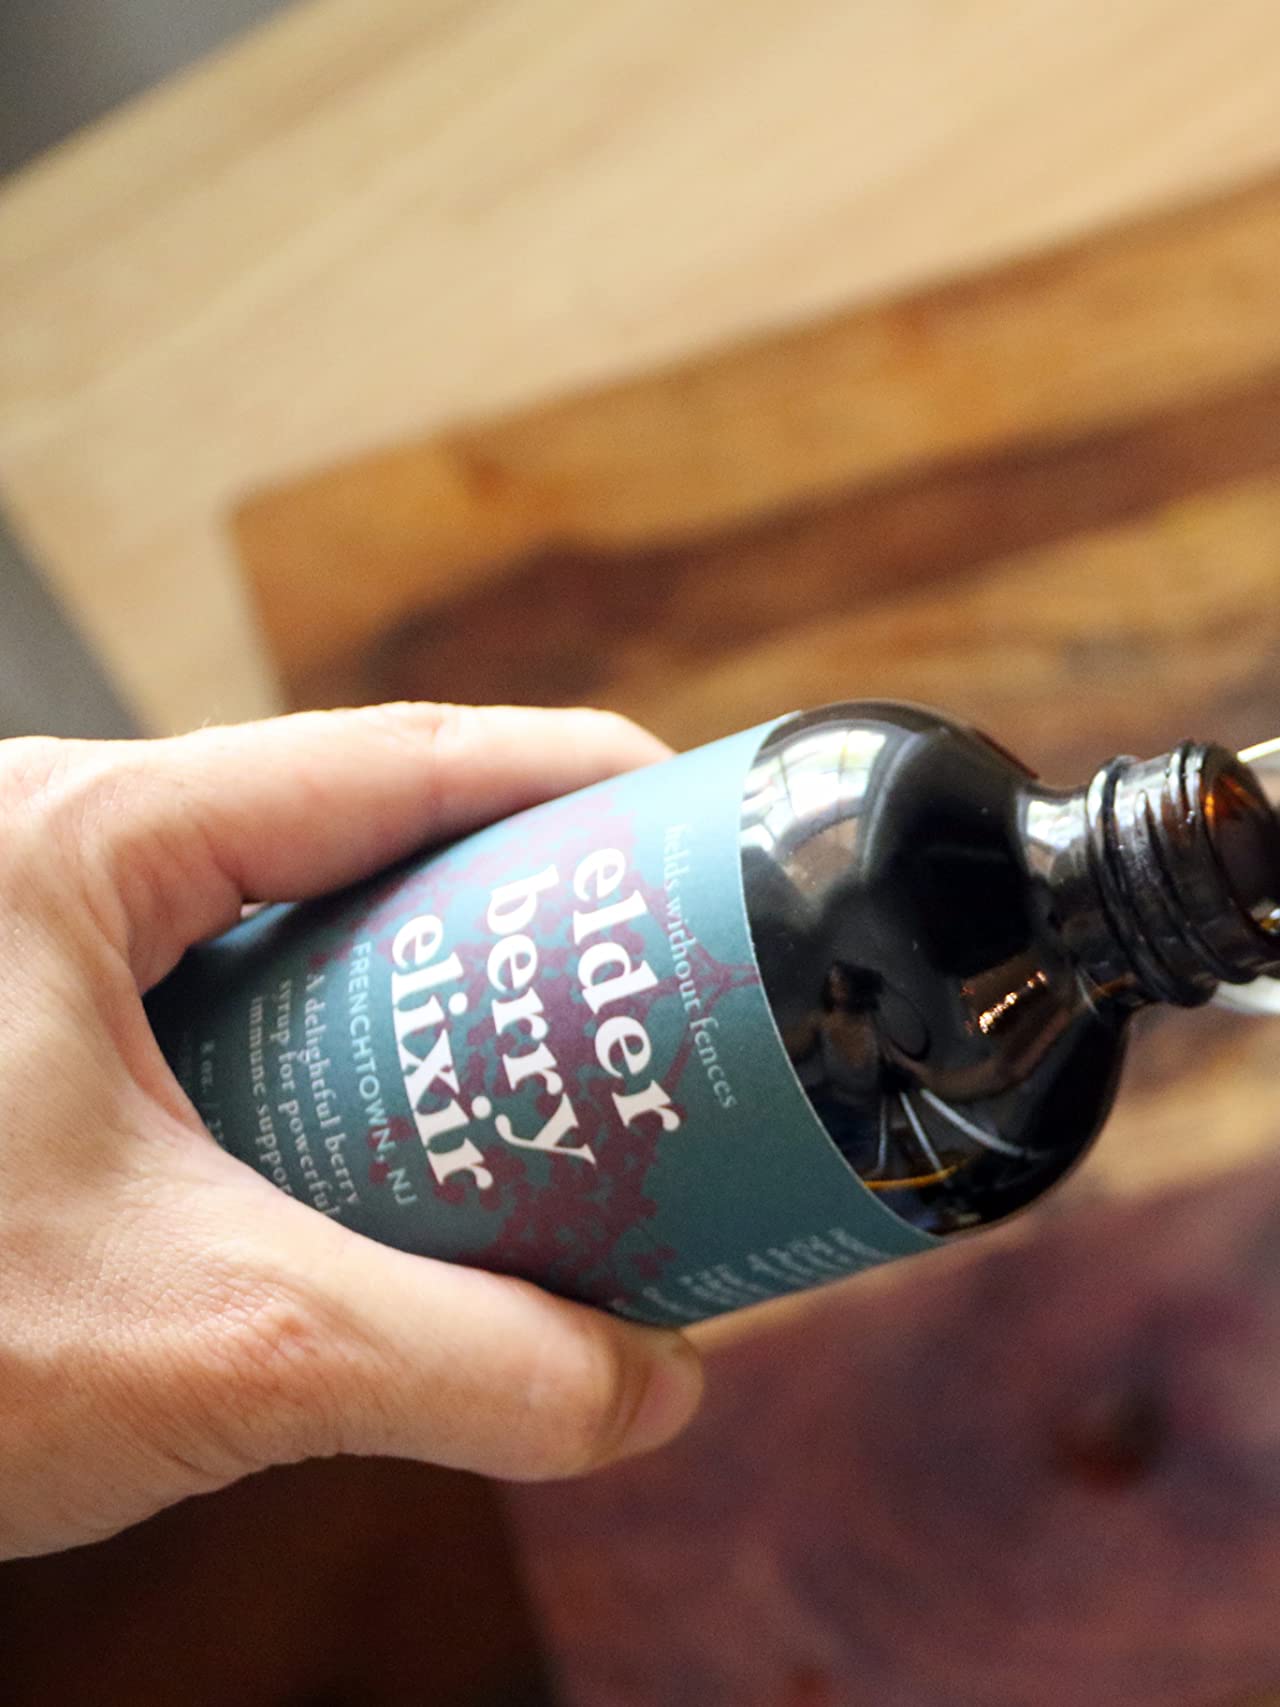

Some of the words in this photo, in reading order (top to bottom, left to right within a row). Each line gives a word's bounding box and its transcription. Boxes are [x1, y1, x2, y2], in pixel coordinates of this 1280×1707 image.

[269, 979, 292, 1046] syrup
[305, 973, 326, 992] A
[487, 864, 596, 1165] berry
[573, 848, 680, 1131] elder
[666, 898, 701, 1013] without
[690, 1015, 737, 1109] fences
[249, 996, 266, 1097] immune
[278, 1050, 301, 1092] for
[297, 997, 340, 1129] delightful
[348, 941, 396, 1161] FRENCHTOWN,
[387, 1167, 417, 1205] NJ
[392, 914, 493, 1189] elixir
[255, 1103, 294, 1195] suppor
[278, 1099, 340, 1216] powerful
[325, 1132, 360, 1204] berry
